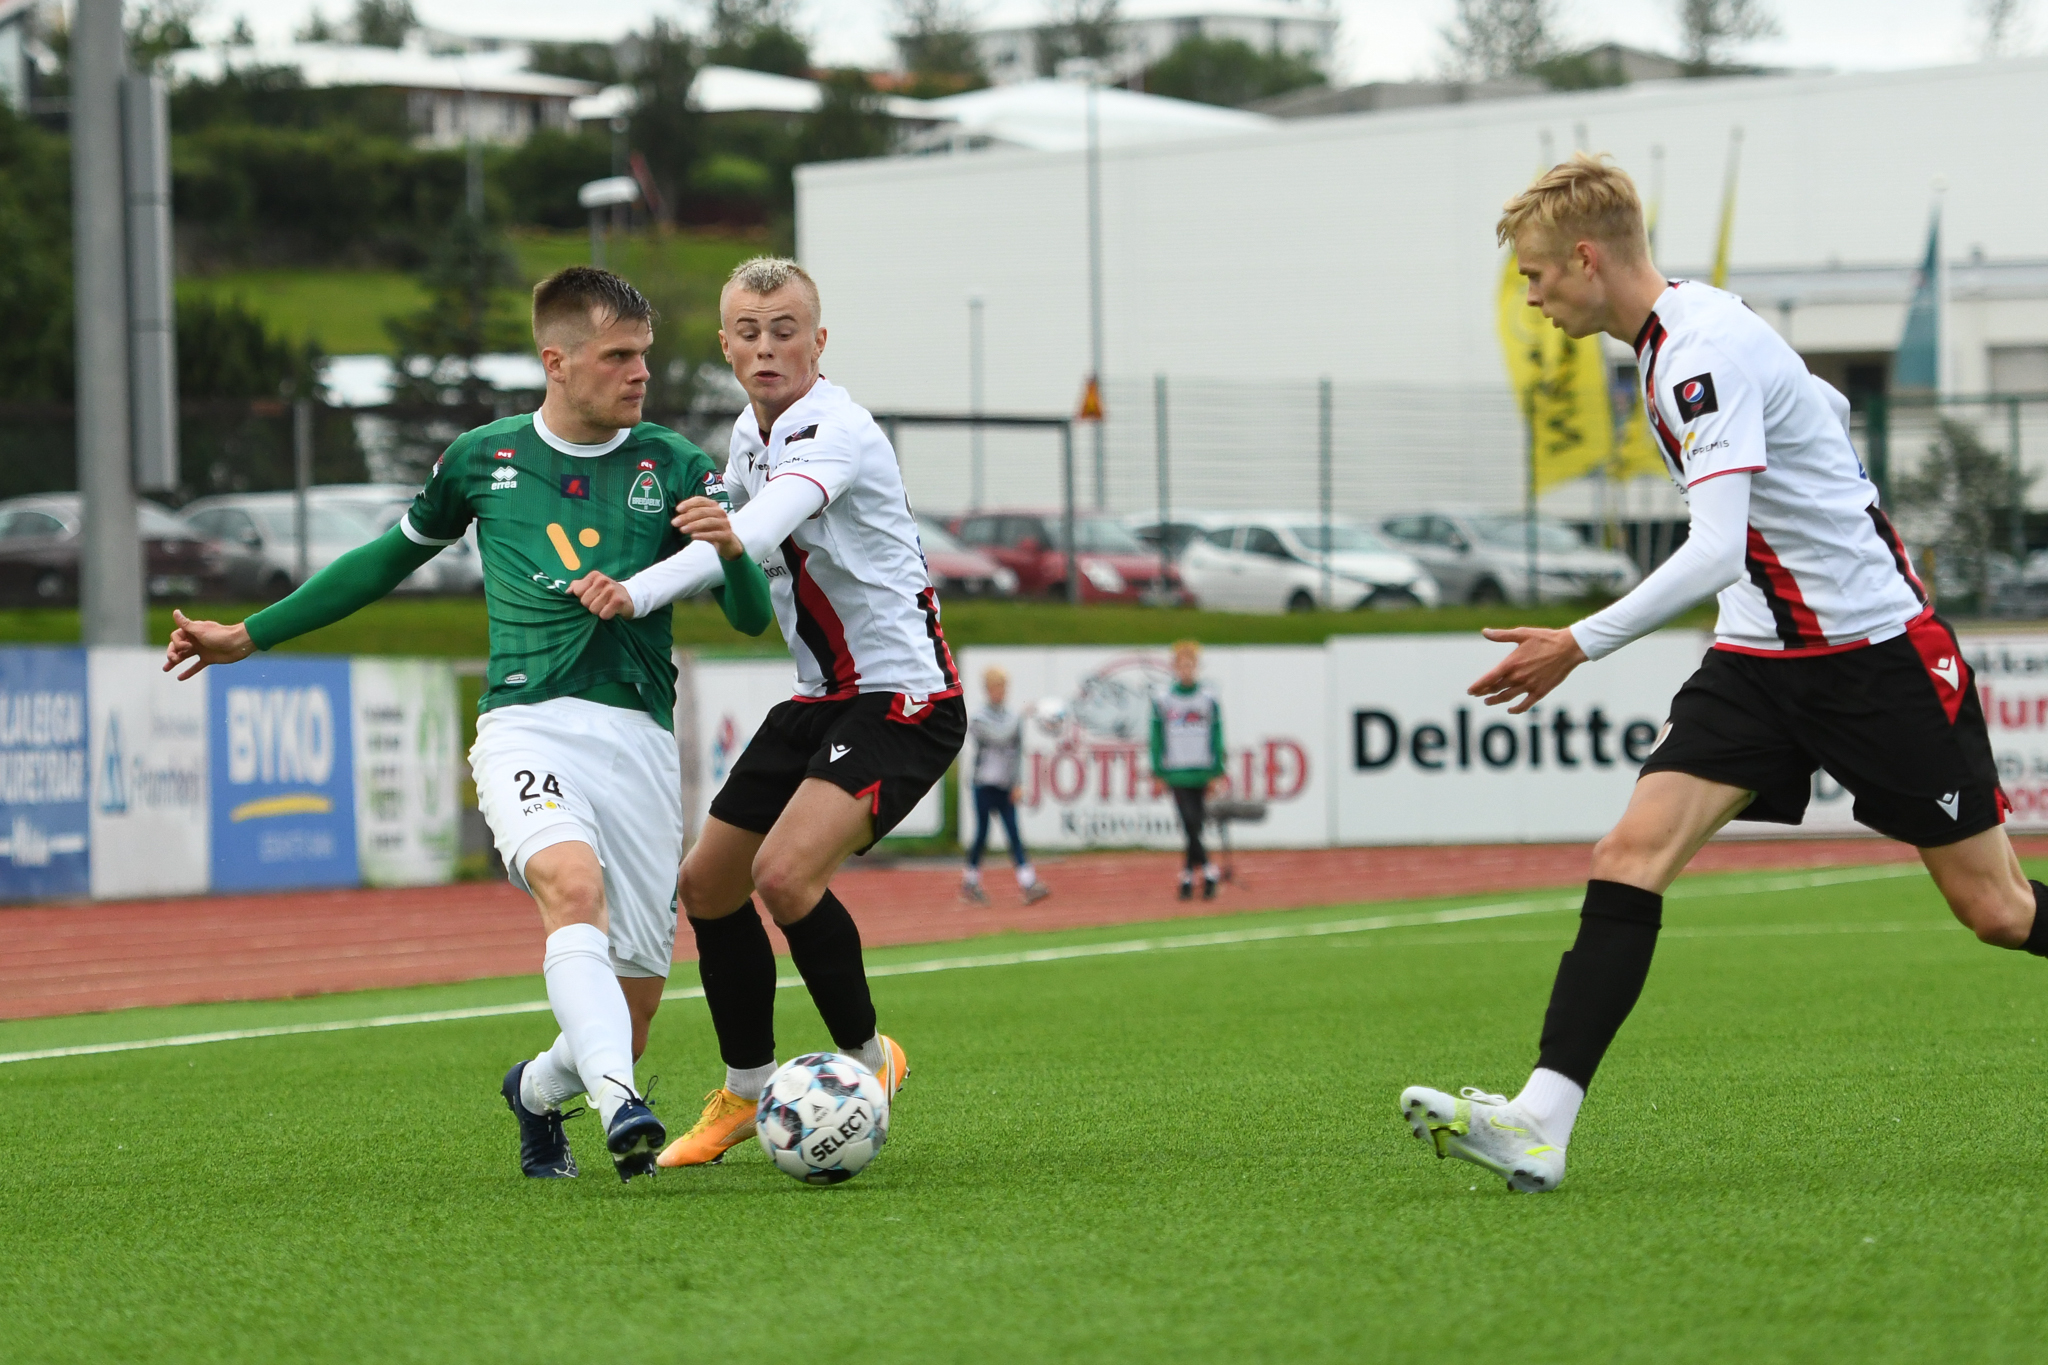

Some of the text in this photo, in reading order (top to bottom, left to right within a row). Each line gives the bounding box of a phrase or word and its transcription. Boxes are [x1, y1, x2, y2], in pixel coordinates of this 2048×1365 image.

[226, 685, 334, 786] BYKO
[1354, 706, 1660, 771] Deloitte
[514, 769, 564, 802] 24
[810, 1104, 869, 1163] SELECT
